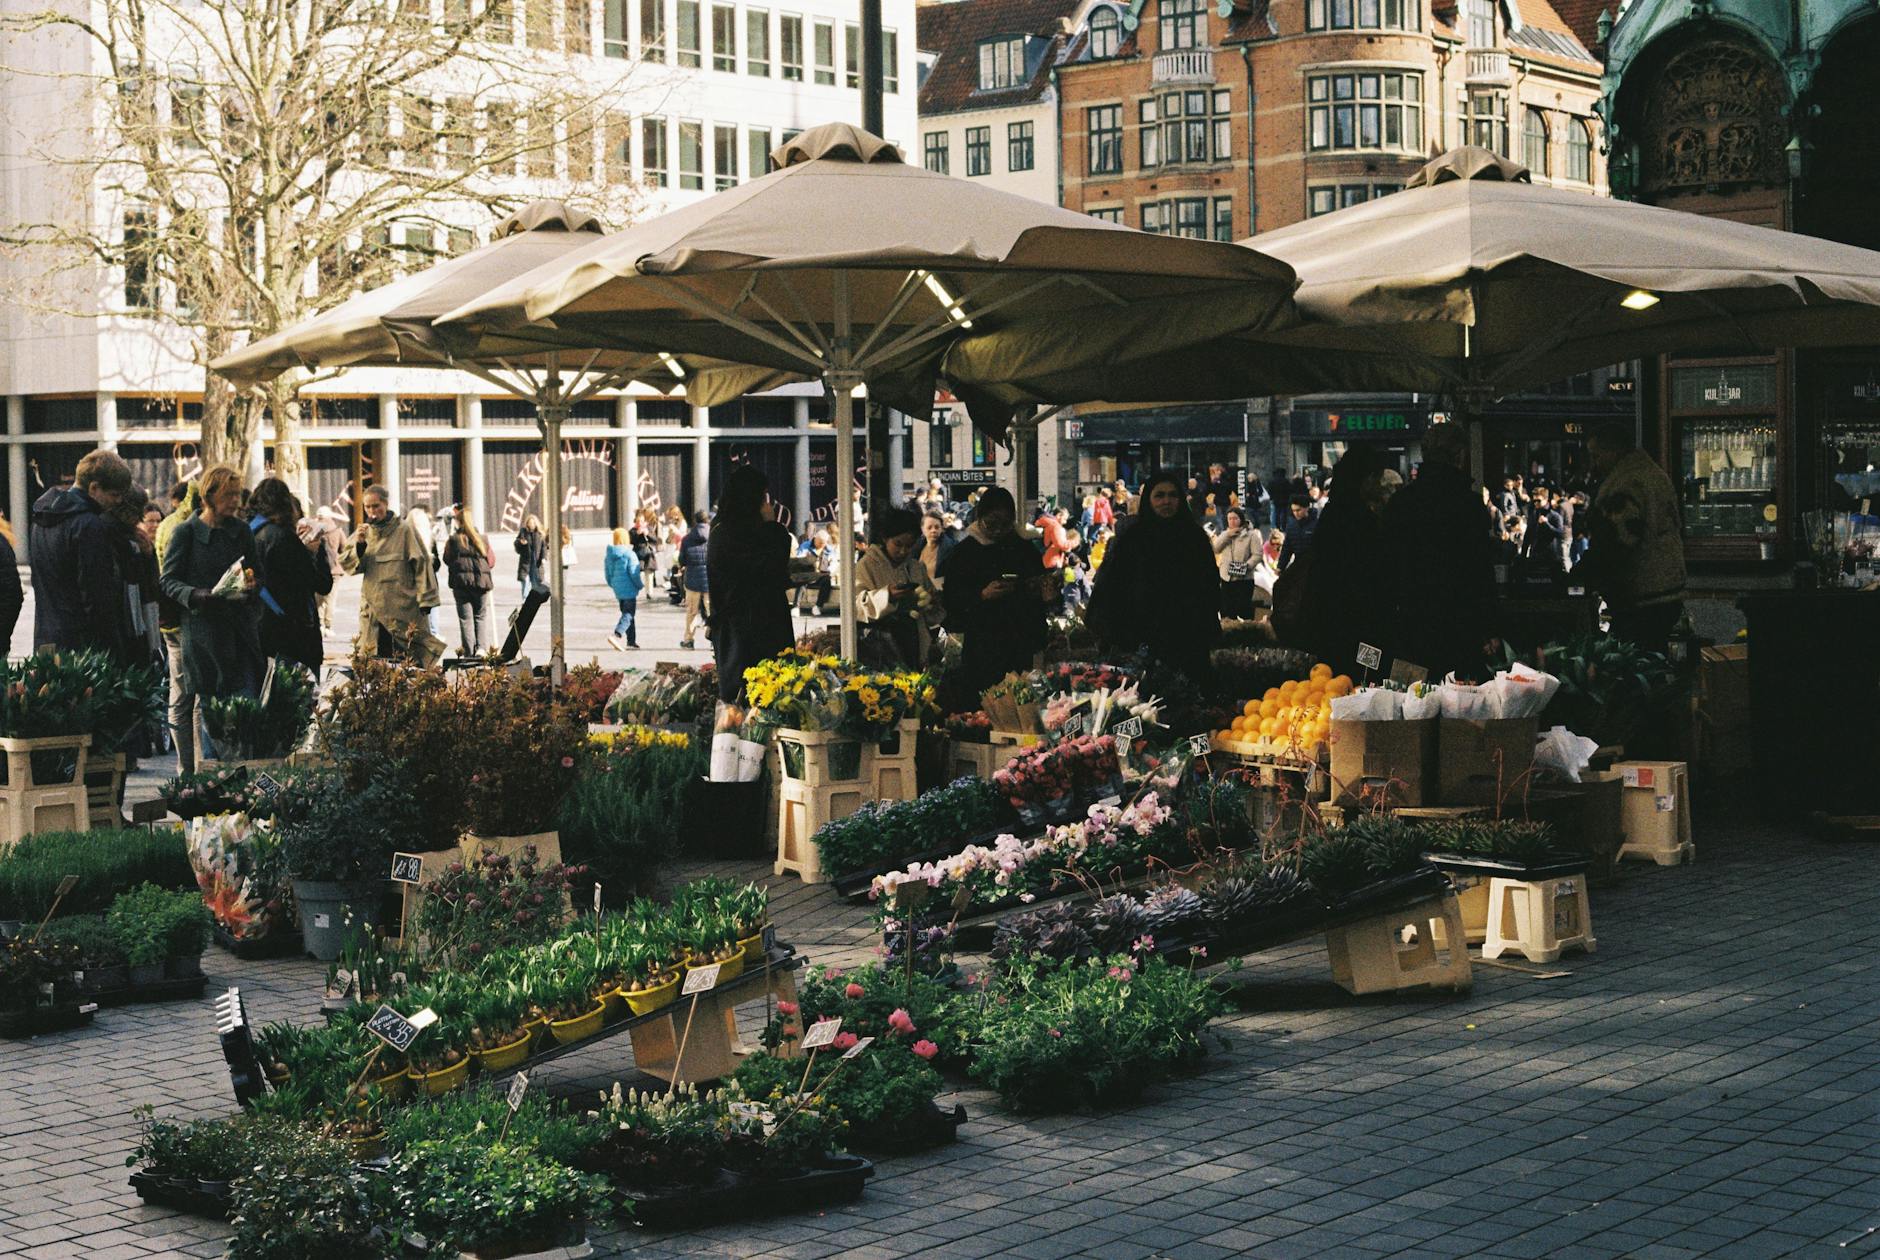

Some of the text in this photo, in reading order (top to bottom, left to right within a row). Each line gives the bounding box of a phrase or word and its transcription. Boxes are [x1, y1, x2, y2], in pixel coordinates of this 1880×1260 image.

[1608, 382, 1634, 391] NEYE
[937, 470, 984, 482] INDIAN BITES
